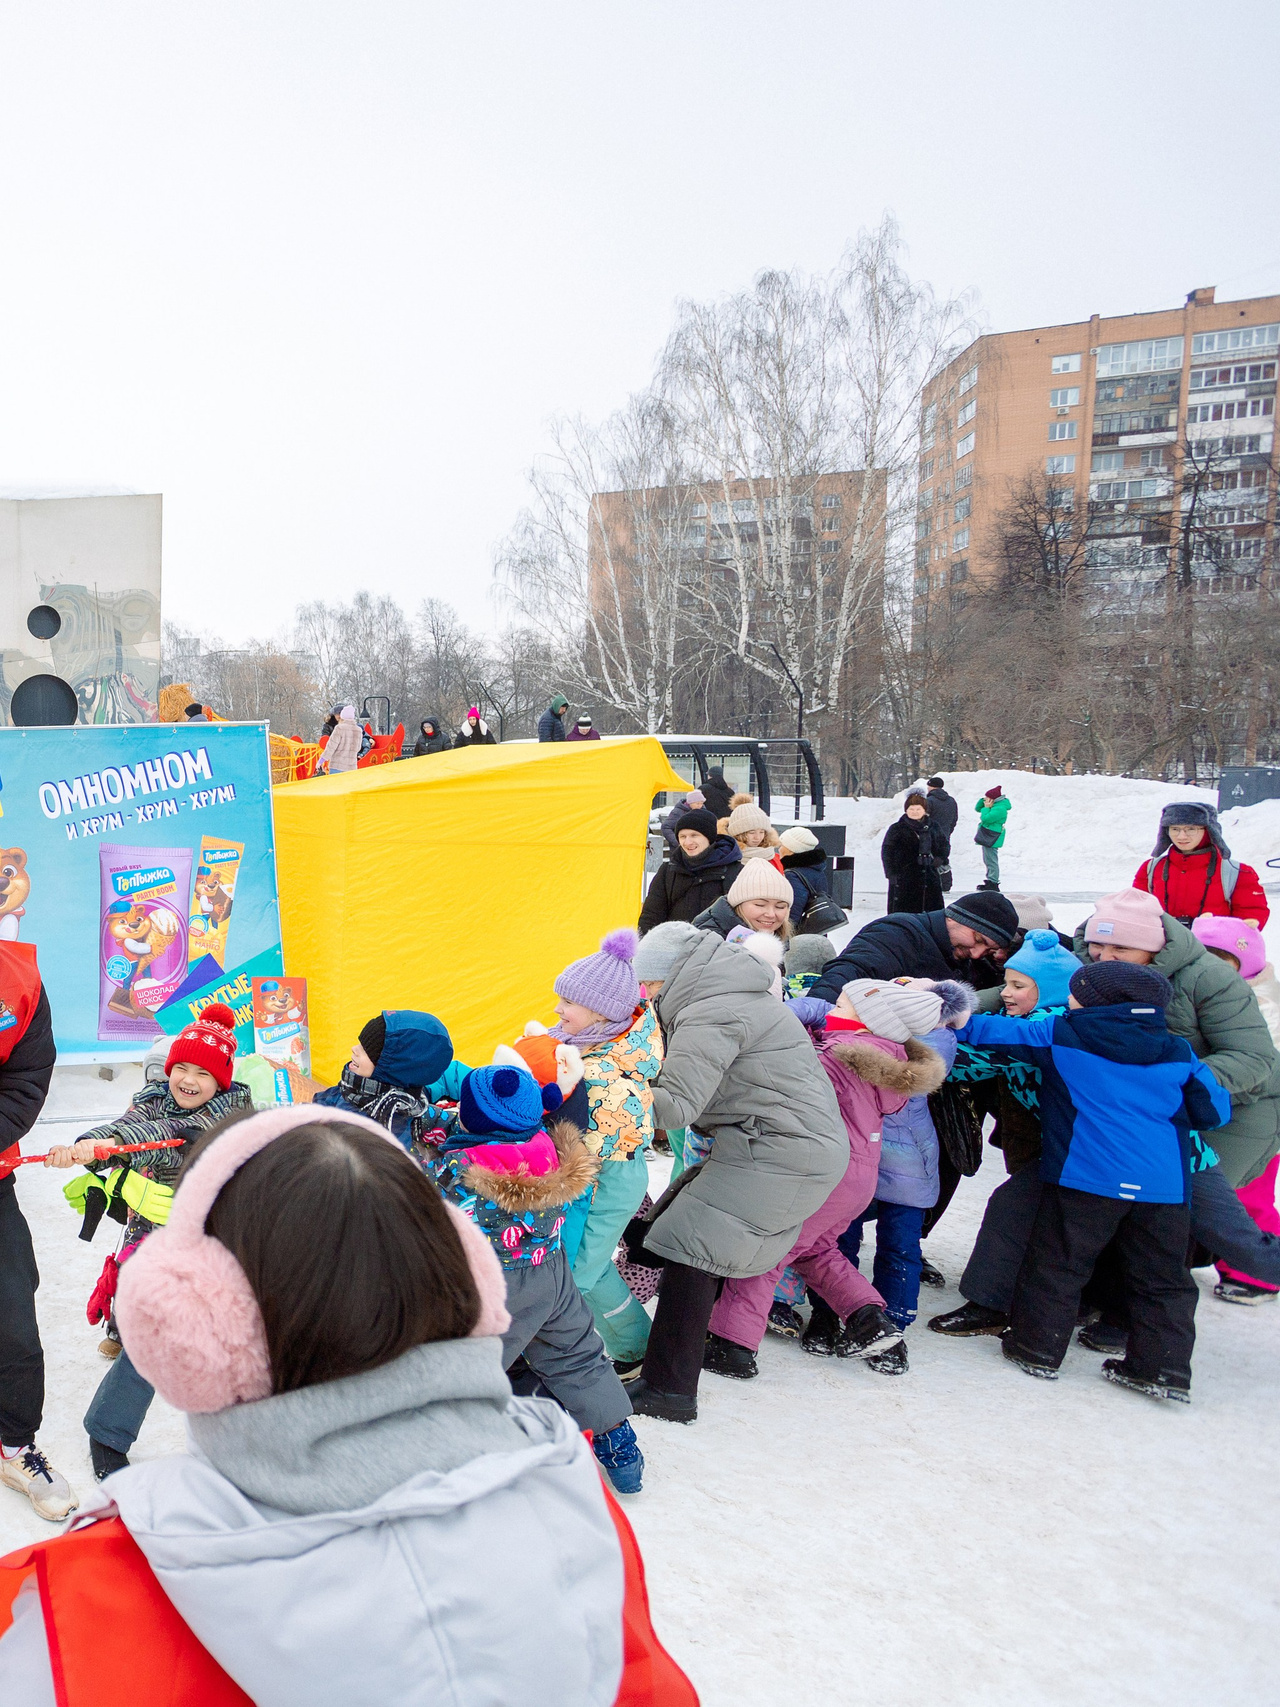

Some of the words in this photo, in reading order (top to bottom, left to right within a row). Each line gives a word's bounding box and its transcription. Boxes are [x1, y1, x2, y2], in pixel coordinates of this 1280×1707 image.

[38, 746, 214, 819] ОМНОМНОМ
[65, 821, 79, 841] И
[80, 811, 124, 838] ХРУМ
[135, 798, 179, 824] ХРУМ
[189, 783, 237, 810] ХРУМ!
[136, 889, 155, 901] PARTY
[156, 884, 174, 895] BOOM
[195, 940, 220, 951] МАНГО
[138, 995, 163, 1005] КОКОС
